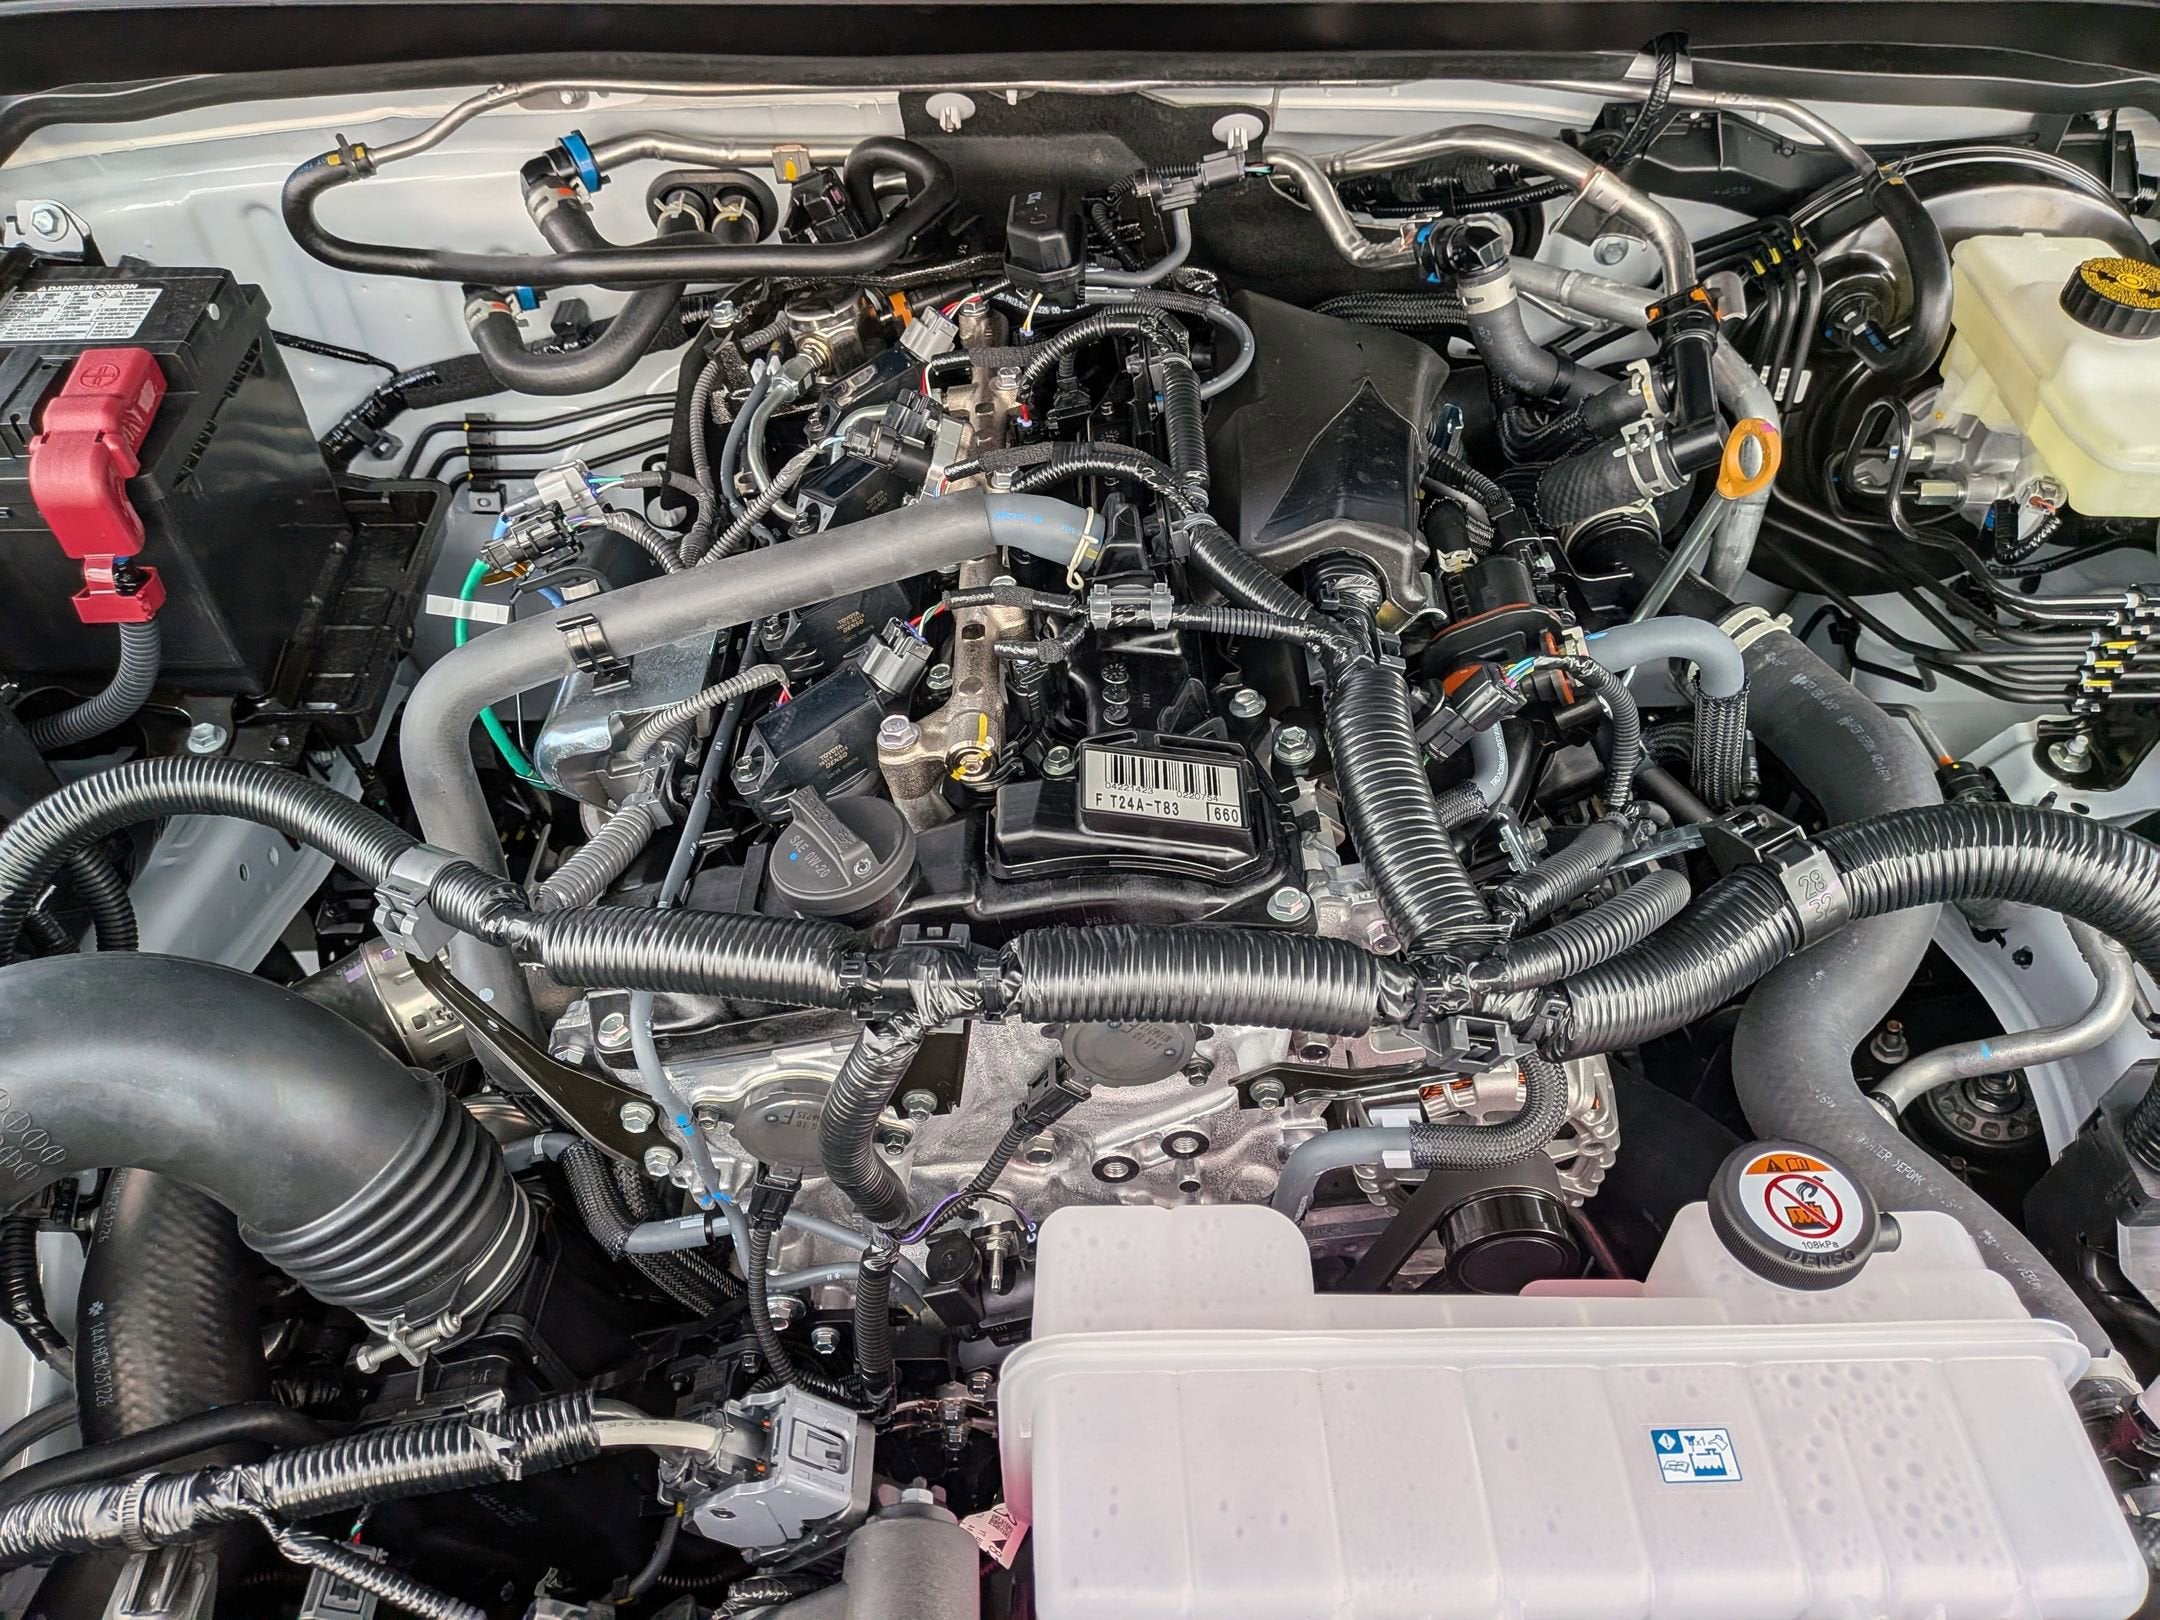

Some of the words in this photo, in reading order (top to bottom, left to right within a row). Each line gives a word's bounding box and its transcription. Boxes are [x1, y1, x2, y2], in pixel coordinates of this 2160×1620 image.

[837, 611, 860, 625] TOYOTA
[842, 619, 864, 634] DENSO
[819, 744, 843, 759] TOYOTA
[825, 751, 848, 769] DENSO
[1104, 782, 1154, 795] 04221423
[1176, 791, 1218, 802] 0220754
[1095, 792, 1103, 807] F
[1109, 794, 1180, 817] T24A-T83
[1214, 806, 1239, 823] 660
[789, 834, 809, 854] SAE
[804, 850, 831, 879] 0W-20
[1798, 868, 1827, 901] 28
[1808, 893, 1838, 924] 32
[1891, 1159, 1927, 1187] >EPDM<
[1801, 1240, 1840, 1250] 108kPa
[1784, 1248, 1856, 1269] DENSO
[1696, 1436, 1706, 1447] x1
